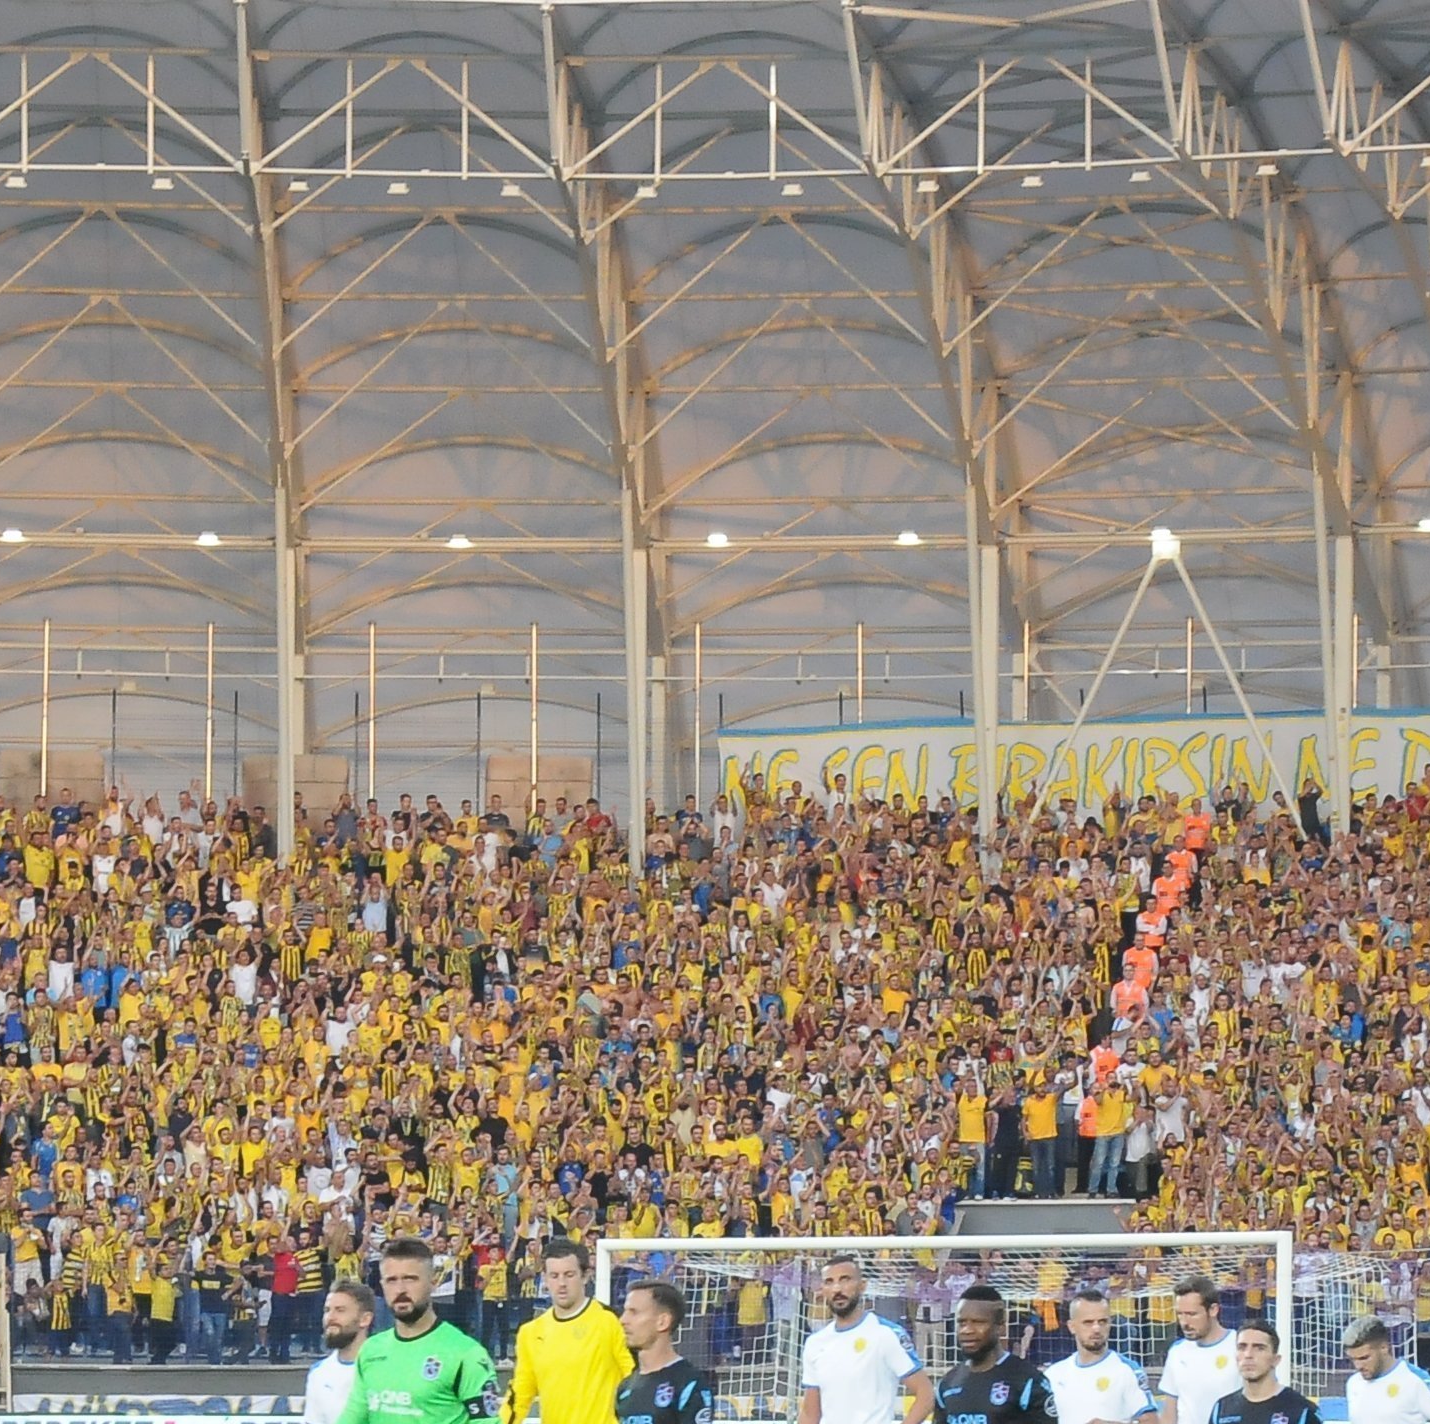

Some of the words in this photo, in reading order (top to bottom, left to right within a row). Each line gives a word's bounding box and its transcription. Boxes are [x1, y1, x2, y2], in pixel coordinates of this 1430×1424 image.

[722, 749, 799, 808] NE
[822, 743, 928, 813] SEN
[1295, 727, 1381, 802] NE
